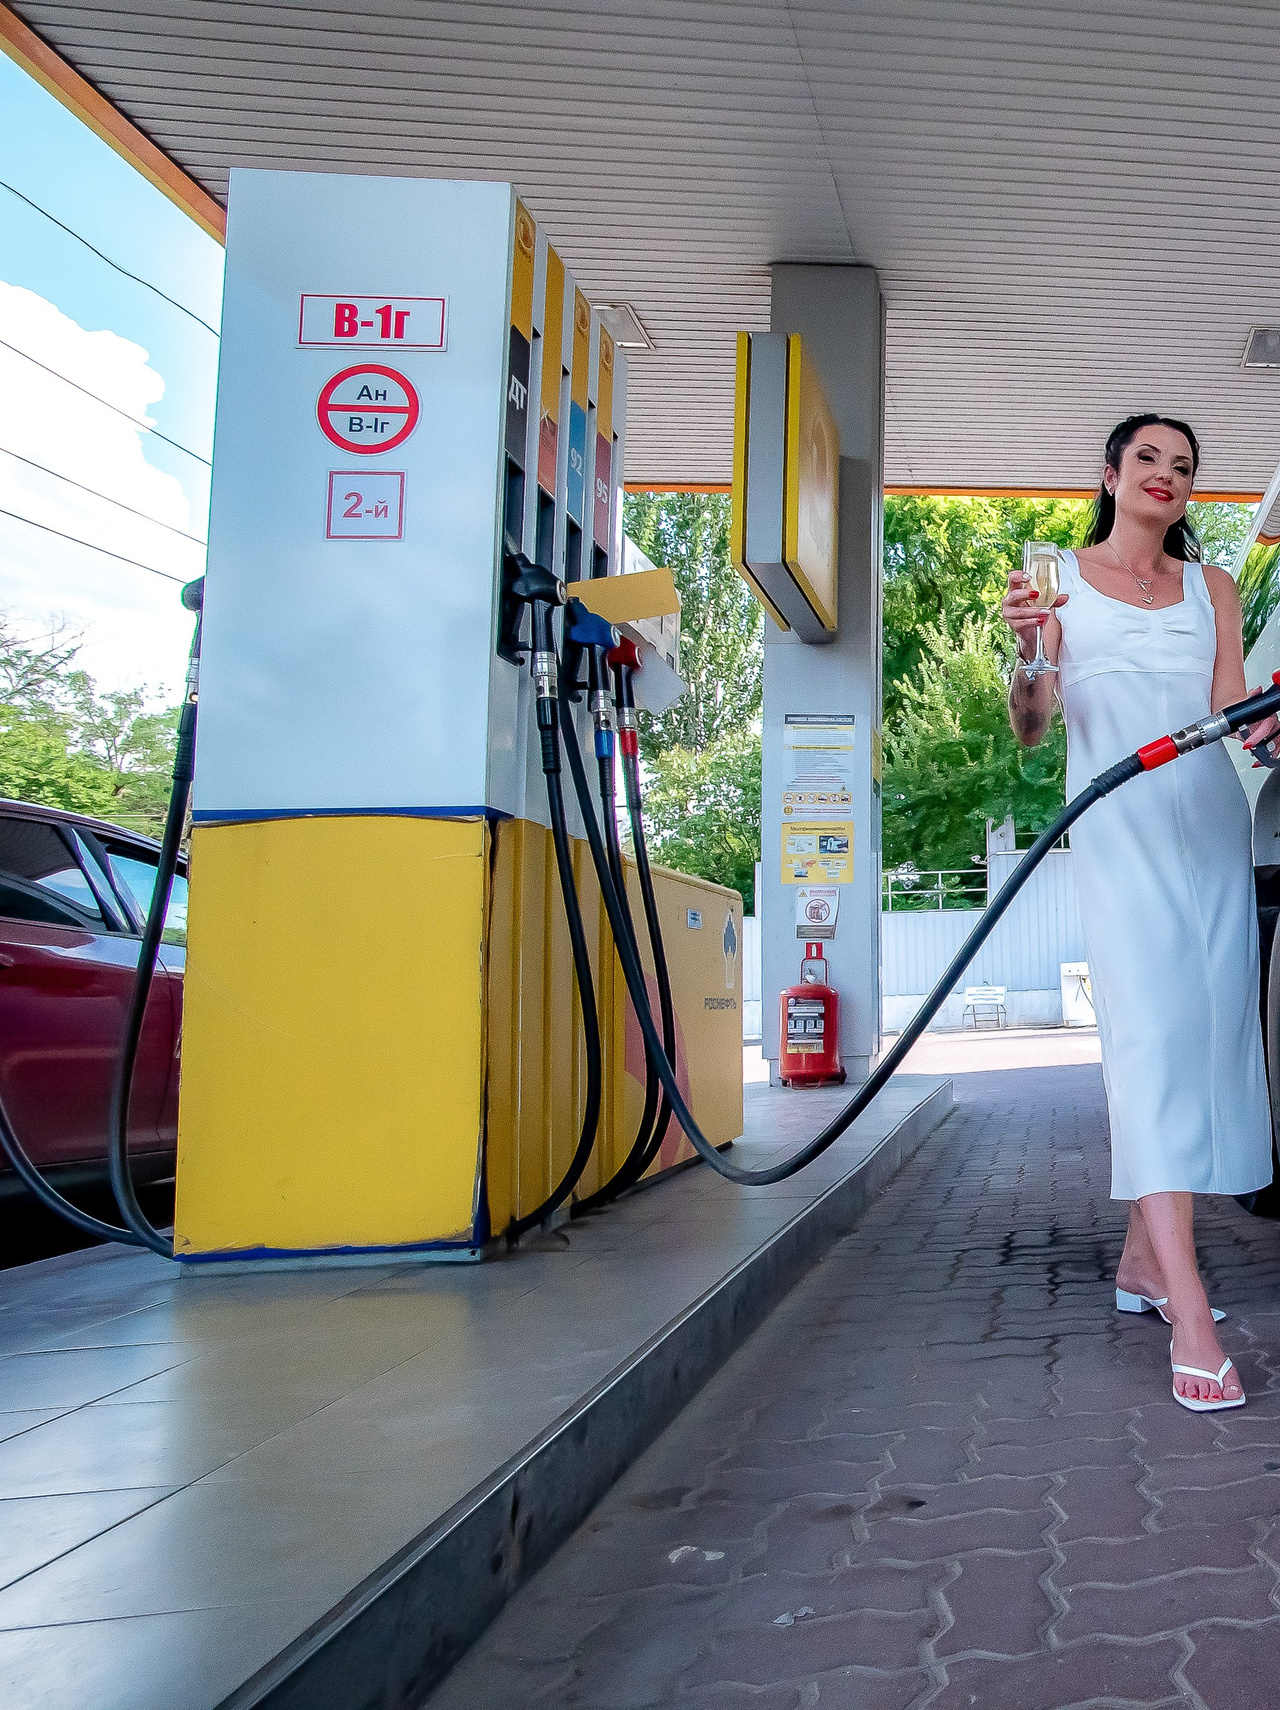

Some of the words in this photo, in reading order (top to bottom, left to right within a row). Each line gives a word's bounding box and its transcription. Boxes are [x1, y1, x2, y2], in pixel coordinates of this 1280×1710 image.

[334, 303, 411, 339] В-1г
[356, 384, 388, 402] Ан
[508, 374, 527, 410] ДТ
[570, 447, 583, 477] 92
[596, 477, 609, 504] 95
[343, 492, 390, 519] 2-й
